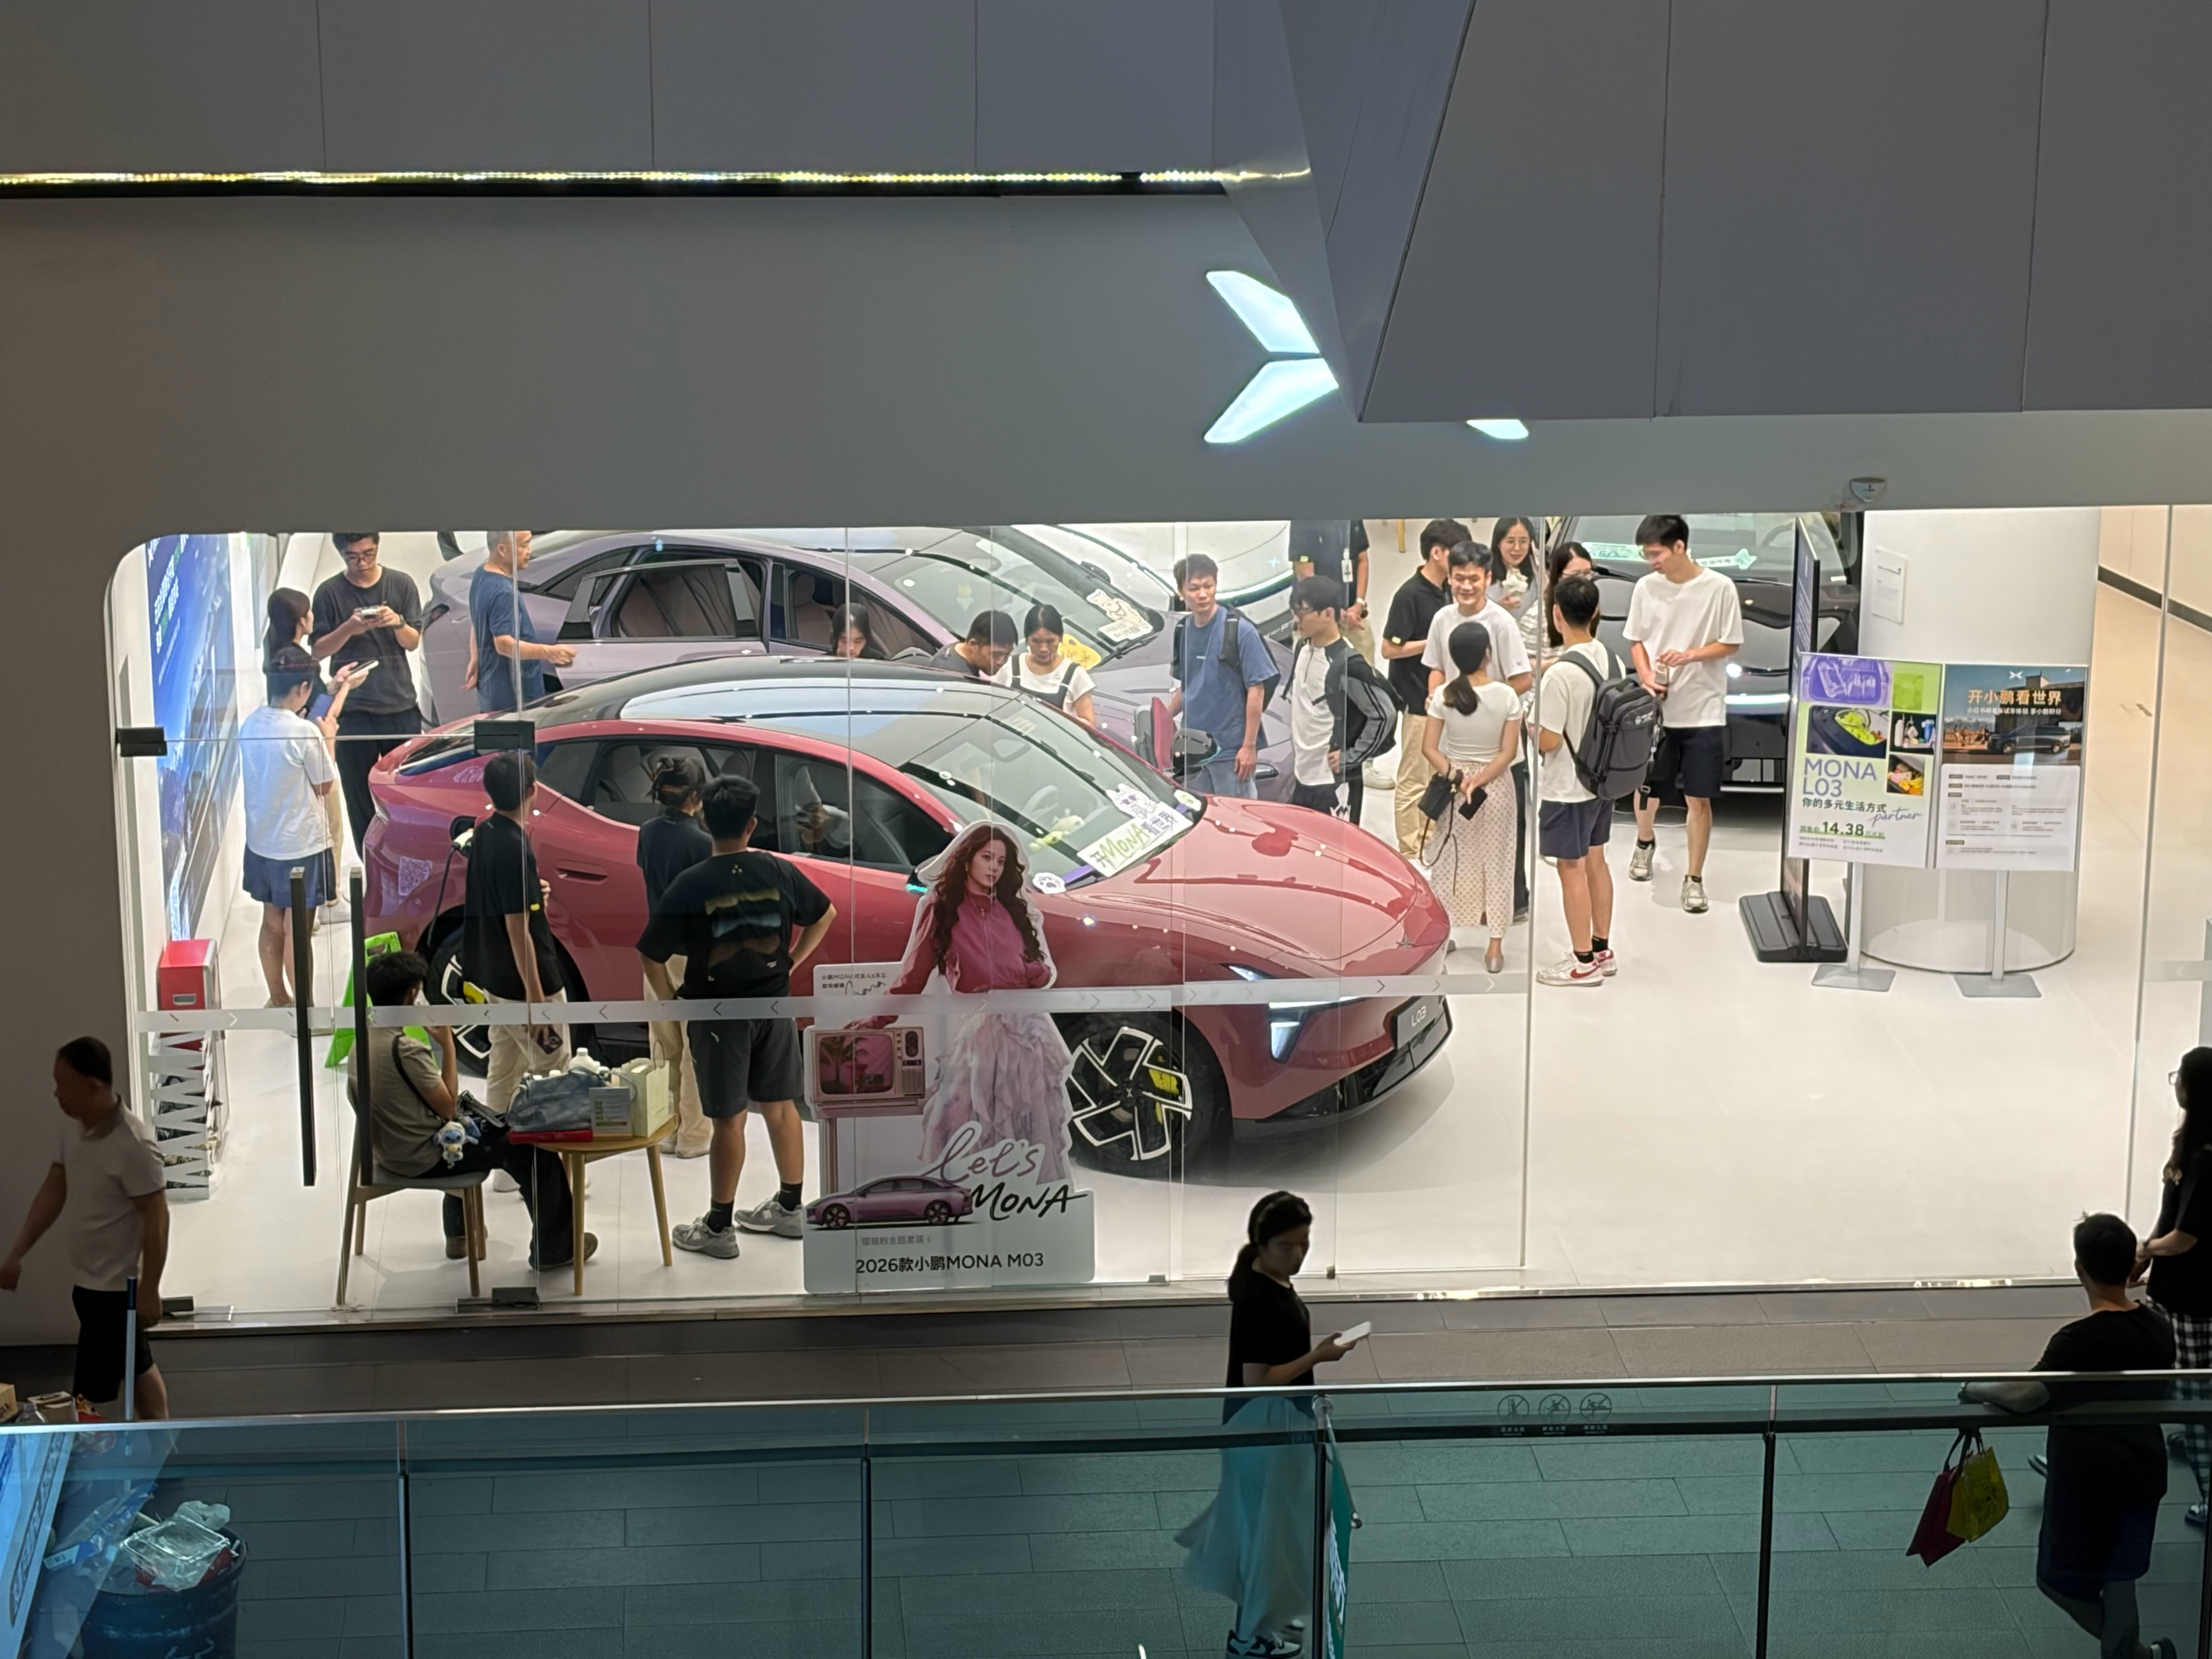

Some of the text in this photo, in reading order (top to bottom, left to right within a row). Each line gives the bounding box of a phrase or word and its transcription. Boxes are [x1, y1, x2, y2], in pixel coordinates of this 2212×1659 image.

[1967, 689, 2062, 706] 开小鹏看世界
[1804, 757, 1877, 781] MONA
[1802, 776, 1842, 798] L03
[1802, 797, 1887, 813] 你的多元生活方式
[1867, 806, 1923, 828] partner
[1822, 821, 1864, 836] 14.38
[1411, 1005, 1427, 1028] L03
[856, 1252, 1045, 1273] 2026款小鹏MONA M03
